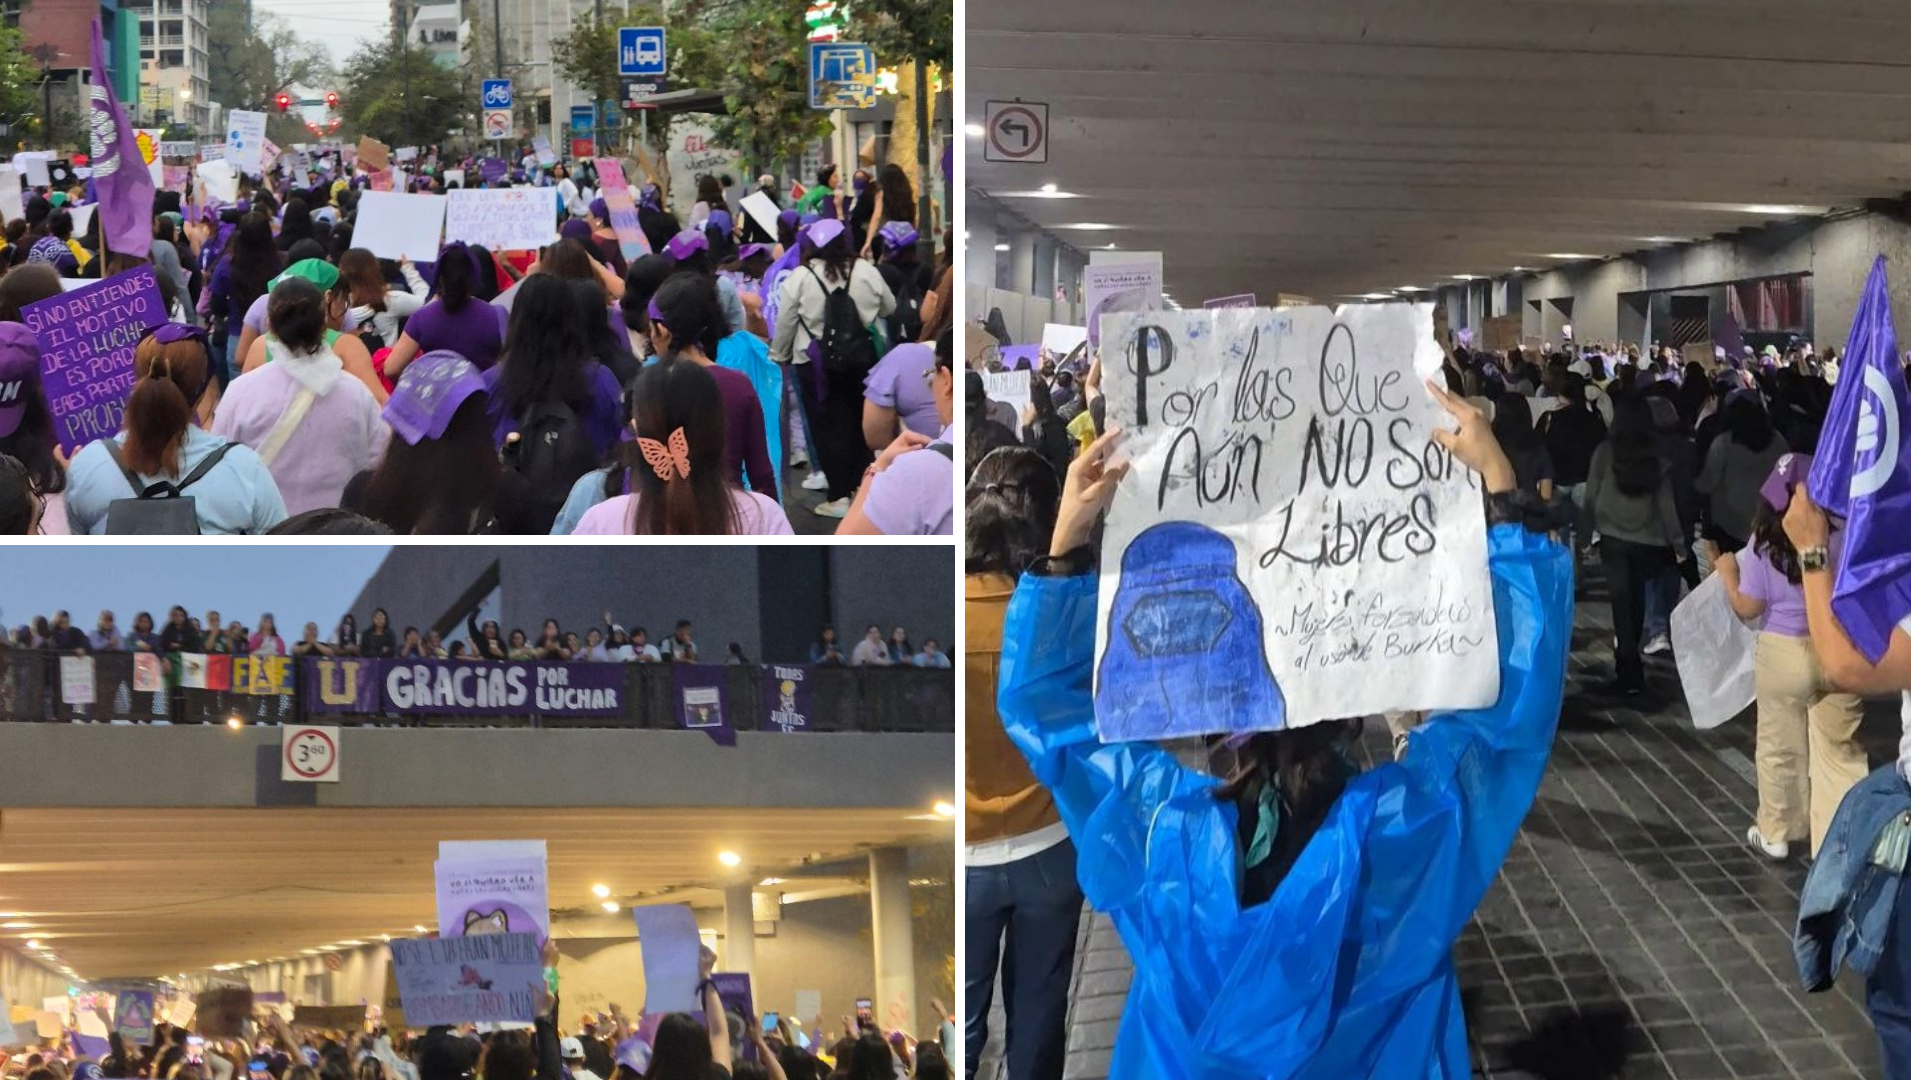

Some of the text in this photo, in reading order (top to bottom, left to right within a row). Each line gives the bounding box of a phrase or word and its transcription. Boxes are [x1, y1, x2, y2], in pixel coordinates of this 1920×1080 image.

[44, 305, 67, 326] NO
[68, 272, 155, 318] ENTIENDES
[76, 296, 147, 337] MOTIVO
[66, 347, 136, 387] ES PORQ
[86, 370, 137, 401] PARTE
[1127, 323, 1410, 427] Por las Que
[1299, 414, 1374, 497] NO
[536, 666, 569, 686] POR
[1294, 641, 1314, 671] al
[535, 686, 619, 710] LUCHAR
